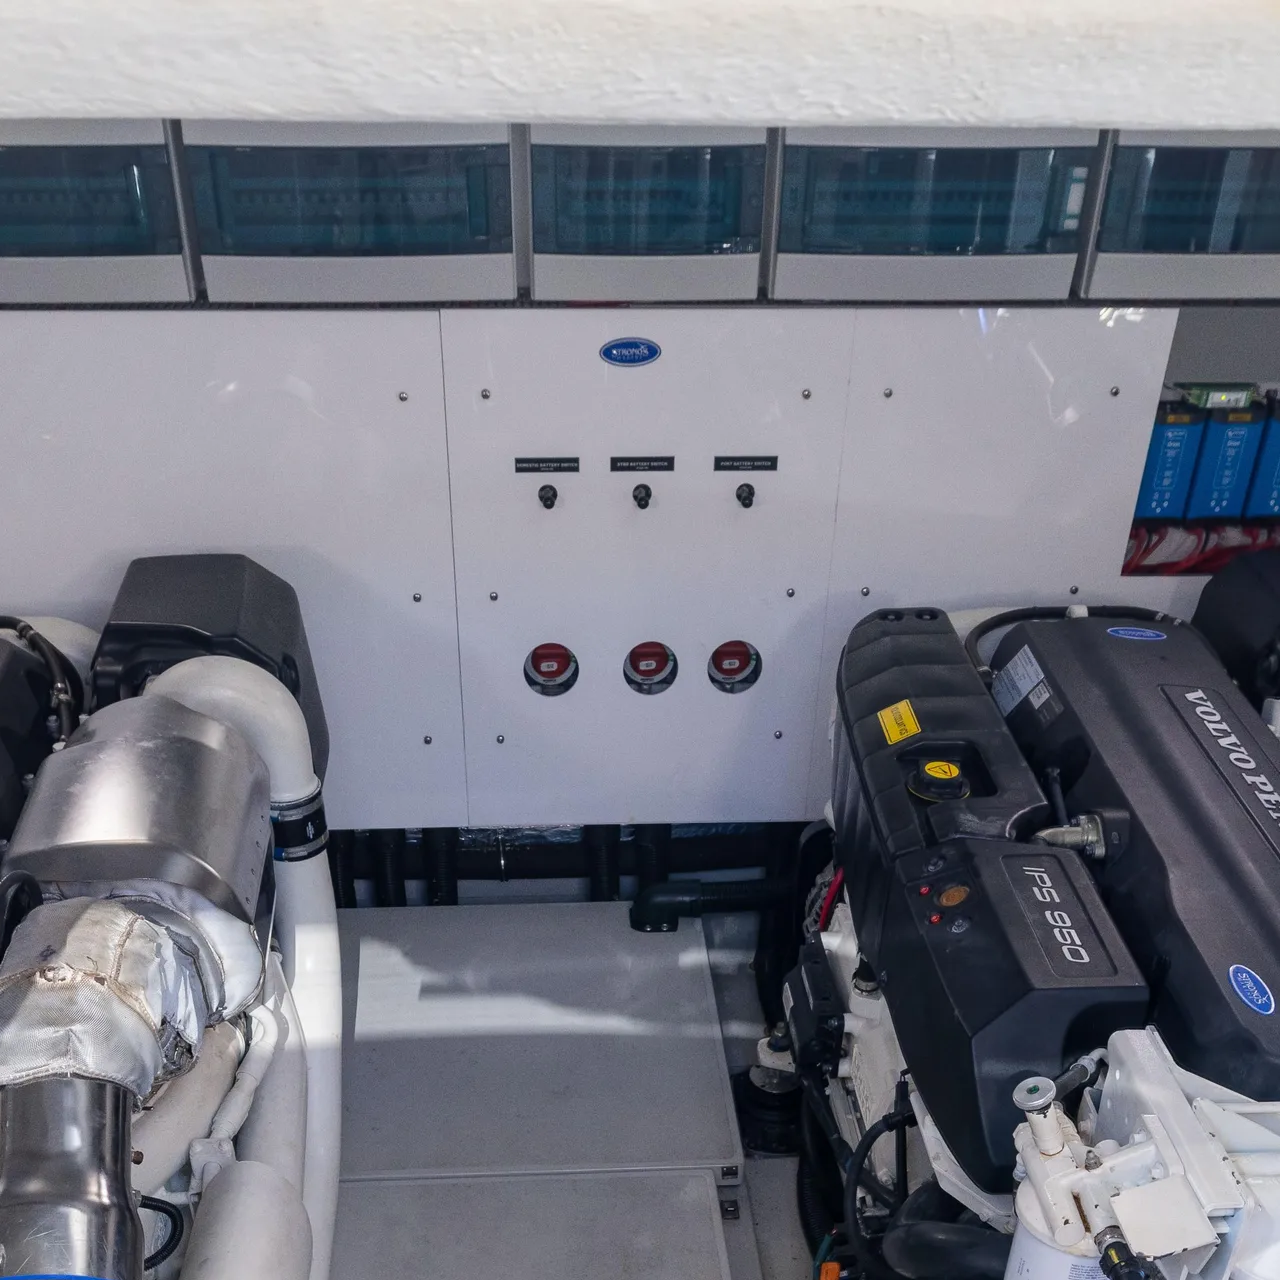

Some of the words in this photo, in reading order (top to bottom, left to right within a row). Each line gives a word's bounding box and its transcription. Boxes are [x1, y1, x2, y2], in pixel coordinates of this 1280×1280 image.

[1184, 688, 1256, 770] VOLVO
[1022, 866, 1061, 903] IPS
[1044, 910, 1091, 963] 950
